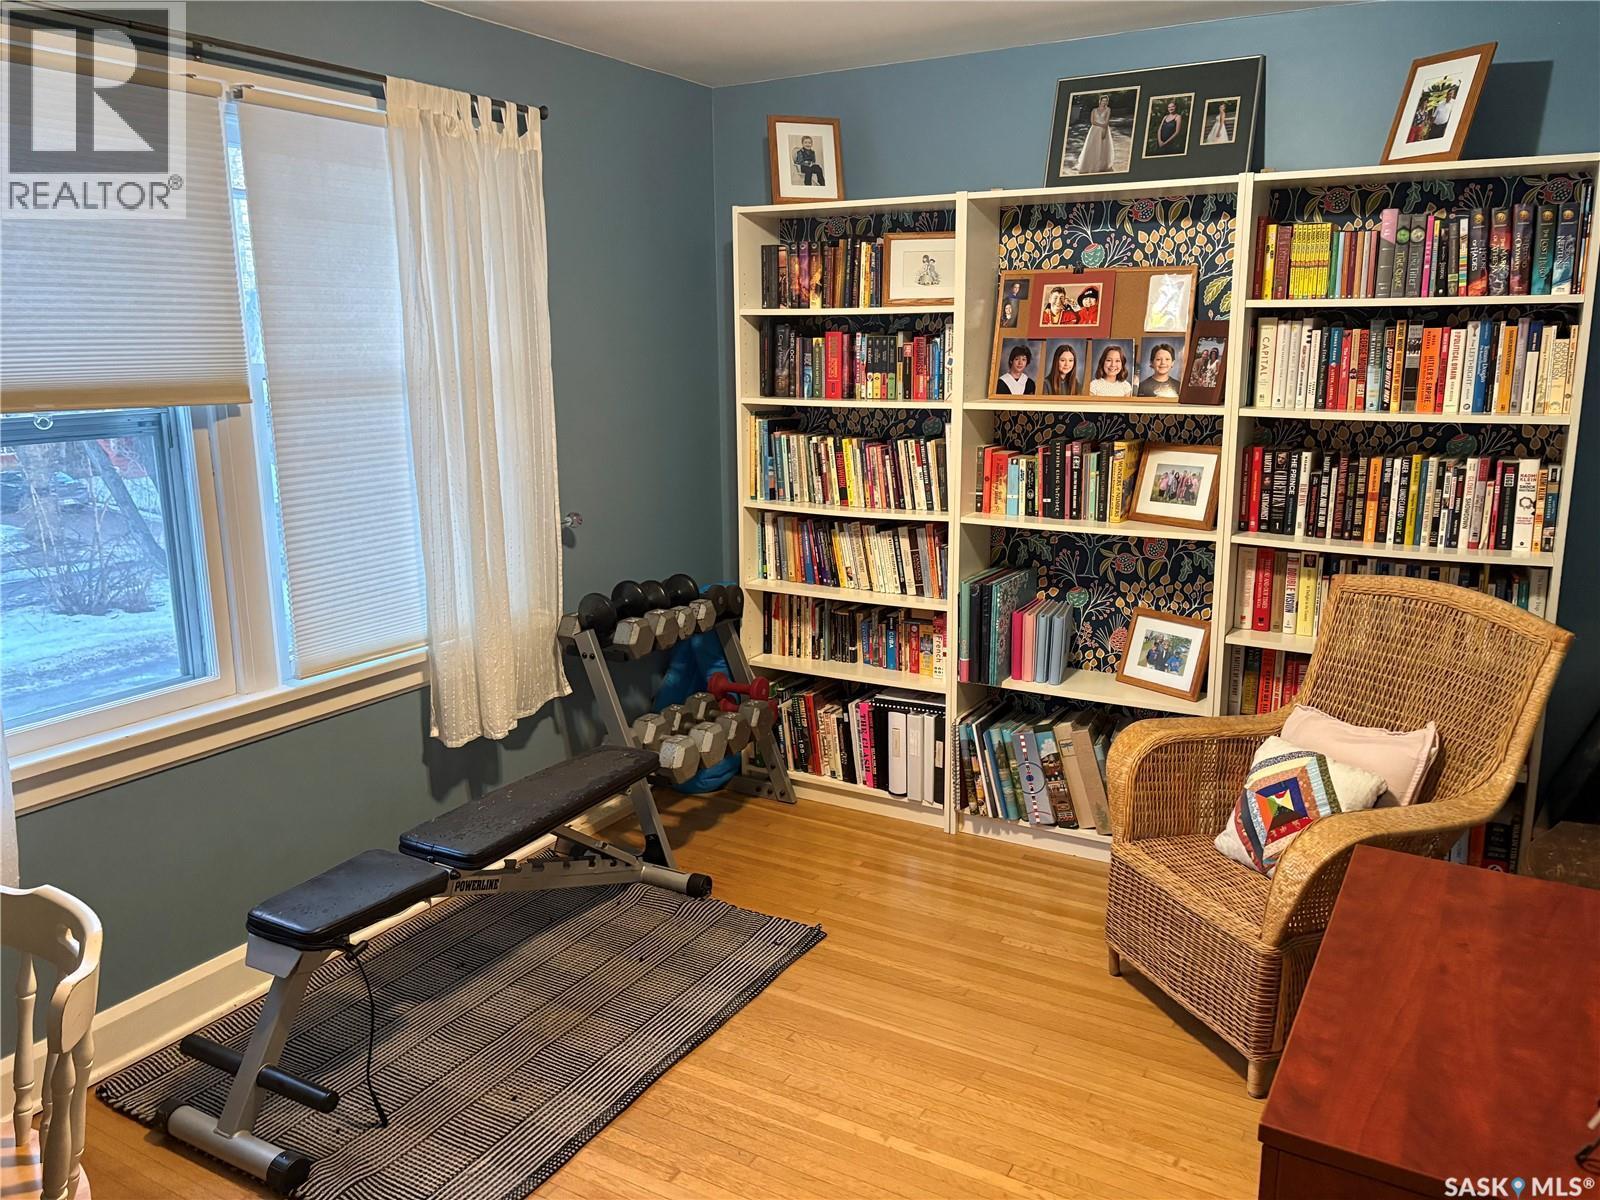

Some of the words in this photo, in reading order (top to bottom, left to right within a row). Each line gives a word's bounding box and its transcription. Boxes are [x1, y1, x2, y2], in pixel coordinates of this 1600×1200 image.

[1540, 238, 1550, 256] LOST
[1470, 246, 1480, 271] HADES
[1479, 248, 1488, 271] HOUSE
[1490, 244, 1500, 274] ATHENA
[1498, 248, 1508, 271] MARK
[1260, 336, 1271, 376] CAPITAL
[1452, 335, 1461, 362] POLITICAL
[1426, 356, 1434, 381] HITLER'S
[1552, 342, 1560, 380] SOCIALISM
[1558, 342, 1568, 378] AGRARIAN
[1450, 363, 1458, 380] BRAIN
[1424, 383, 1432, 404] EMPIRE
[1290, 454, 1298, 468] THE
[1340, 457, 1349, 474] LINDA
[1402, 459, 1410, 474] LAXER
[1116, 460, 1124, 486] WONDERS
[1288, 469, 1298, 496] PRINCE
[1540, 472, 1548, 485] NAOMI
[1320, 484, 1328, 498] QUICK
[1466, 476, 1474, 496] GLOBAL
[1538, 488, 1546, 501] KLEIN
[1318, 508, 1327, 516] THE
[1320, 498, 1328, 507] AND
[1398, 488, 1406, 518] UNDECLARED
[1318, 516, 1326, 528] DEAD
[1462, 498, 1472, 530] SHOWDOWN
[1286, 568, 1297, 592] DOUBLE
[1284, 592, 1296, 614] VISION
[862, 738, 870, 773] CLASH
[455, 879, 500, 892] POWERLINE
